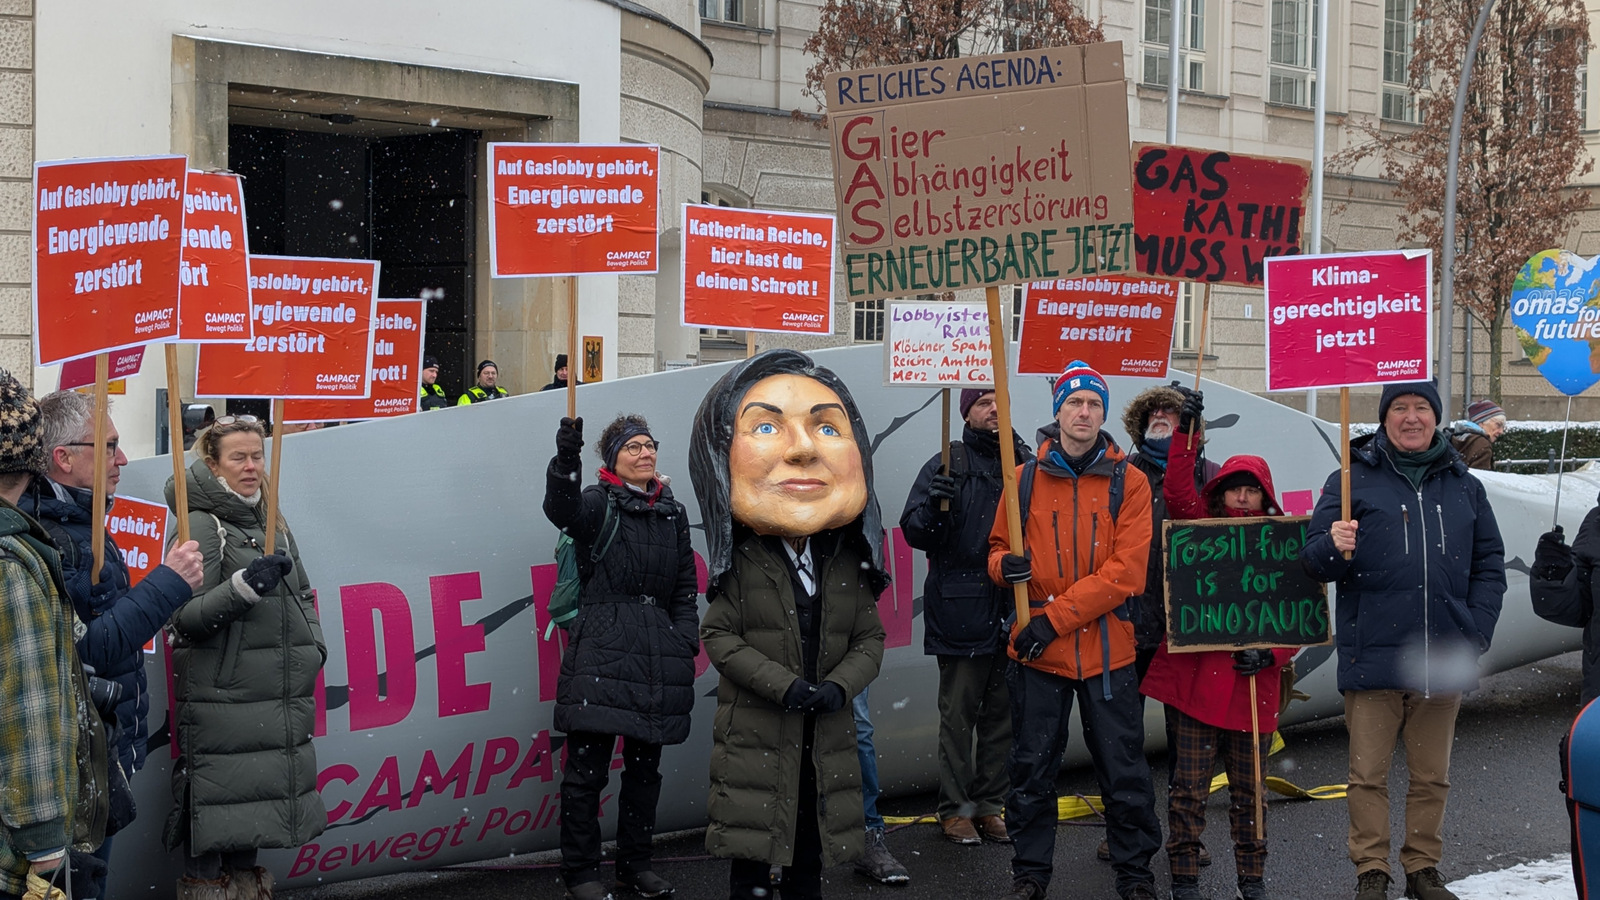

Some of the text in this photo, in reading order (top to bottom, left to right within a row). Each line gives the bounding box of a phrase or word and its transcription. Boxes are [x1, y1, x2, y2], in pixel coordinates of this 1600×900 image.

[838, 56, 1062, 105] REICHES AGENDA:
[498, 160, 654, 178] Auf Gaslobby gehört,
[844, 140, 1072, 204] Abhängigkeit
[1136, 149, 1230, 200] GAS
[40, 178, 180, 211] Auf Gaslobby gehört,
[186, 190, 238, 214] gehört,
[508, 185, 643, 208] Energiewende
[537, 214, 614, 234] zerstört
[849, 187, 1108, 245] Selbstzerstörung
[1183, 199, 1300, 244] KATHI
[48, 214, 169, 255] Energiewende
[690, 218, 828, 248] Katherina Reiche,
[606, 252, 651, 260] CAMPACT
[711, 246, 802, 270] hier hast du
[846, 230, 1059, 296] ERNEUERBARE
[1134, 233, 1227, 282] MUSS
[75, 259, 142, 294] zerstört
[250, 274, 368, 295] aslobby gehört,
[696, 272, 748, 291] deinen
[1312, 266, 1378, 286] Klima-
[1032, 278, 1174, 296] Auf Gaslobby gehört,
[135, 308, 173, 324] CAMPACT
[254, 301, 356, 326] rgiewende
[1038, 299, 1162, 320] Energiewende
[1274, 294, 1422, 324] gerechtigkeit
[1514, 297, 1580, 316] omas
[134, 321, 170, 334] Bewegt Politik
[205, 313, 246, 323] CAMPACT
[374, 313, 417, 331] eiche,
[782, 313, 824, 322] CAMPACT
[782, 320, 802, 328] Bewegt
[206, 325, 226, 334] Bewegt
[1060, 326, 1132, 342] zerstört
[1534, 319, 1600, 340] future
[245, 333, 325, 353] zerstört
[376, 339, 394, 355] du
[1122, 359, 1163, 367] CAMPACT
[1377, 360, 1422, 370] CAMPACT
[316, 374, 360, 383] CAMPACT
[893, 369, 990, 381] Merz und Co.
[316, 383, 338, 392] Bewegt
[374, 398, 412, 406] CAMPACT
[374, 406, 392, 414] Bewegt
[110, 516, 160, 540] gehört,
[1170, 526, 1246, 569] Fossil
[1196, 565, 1284, 596] is for
[1180, 598, 1328, 636] DINOSAURS
[317, 729, 624, 823] CAMPA
[288, 792, 614, 879] Bewegt Poli
